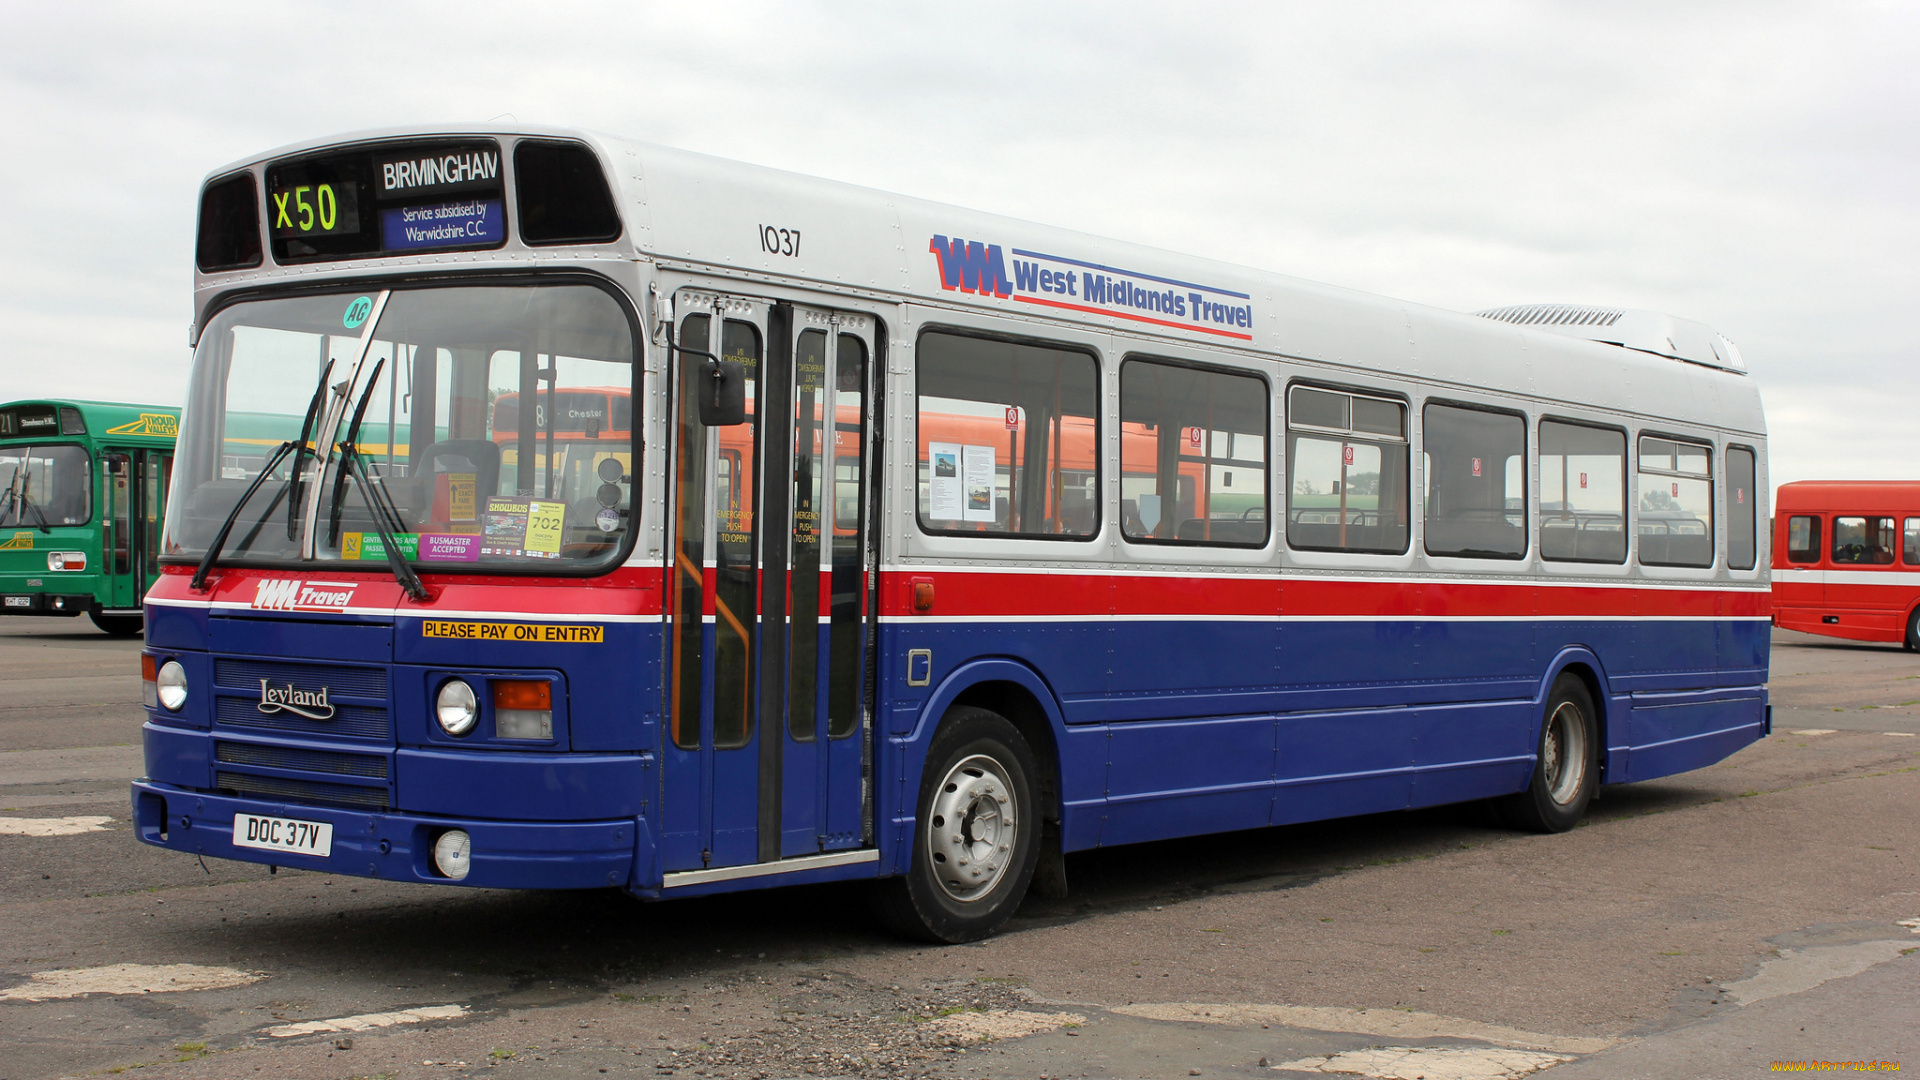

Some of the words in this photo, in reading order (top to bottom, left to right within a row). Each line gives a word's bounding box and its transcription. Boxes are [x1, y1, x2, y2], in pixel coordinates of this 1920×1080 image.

[383, 151, 498, 190] BIRMINGHAM
[273, 183, 337, 231] X50
[403, 206, 433, 222] Service
[434, 202, 475, 219] subsidised
[476, 201, 487, 219] by
[405, 222, 464, 242] Warwickshire
[466, 220, 487, 237] C.C.
[758, 223, 801, 258] 1037
[1013, 259, 1077, 296] West
[1083, 272, 1186, 317] Midlands
[1188, 293, 1253, 329] Travel
[347, 302, 369, 322] AG
[568, 408, 603, 419] Chester
[732, 500, 739, 508] IN
[532, 516, 560, 531] 702
[717, 509, 754, 520] EMERGENCY
[726, 522, 742, 532] PUSH
[799, 522, 813, 532] PUSH
[429, 536, 472, 546] BUSMASTER
[721, 533, 730, 542] TO
[730, 533, 748, 543] OPEN
[795, 534, 802, 543] TO
[802, 534, 816, 543] OPEN
[431, 545, 466, 554] ACCEPTED
[298, 588, 354, 606] Travel
[425, 622, 476, 638] PLEASE
[481, 624, 508, 639] PAY
[513, 625, 538, 640] ON
[545, 626, 601, 642] ENTRY
[259, 679, 332, 716] Leyland
[247, 817, 282, 844] DOC
[285, 822, 320, 849] 37V
